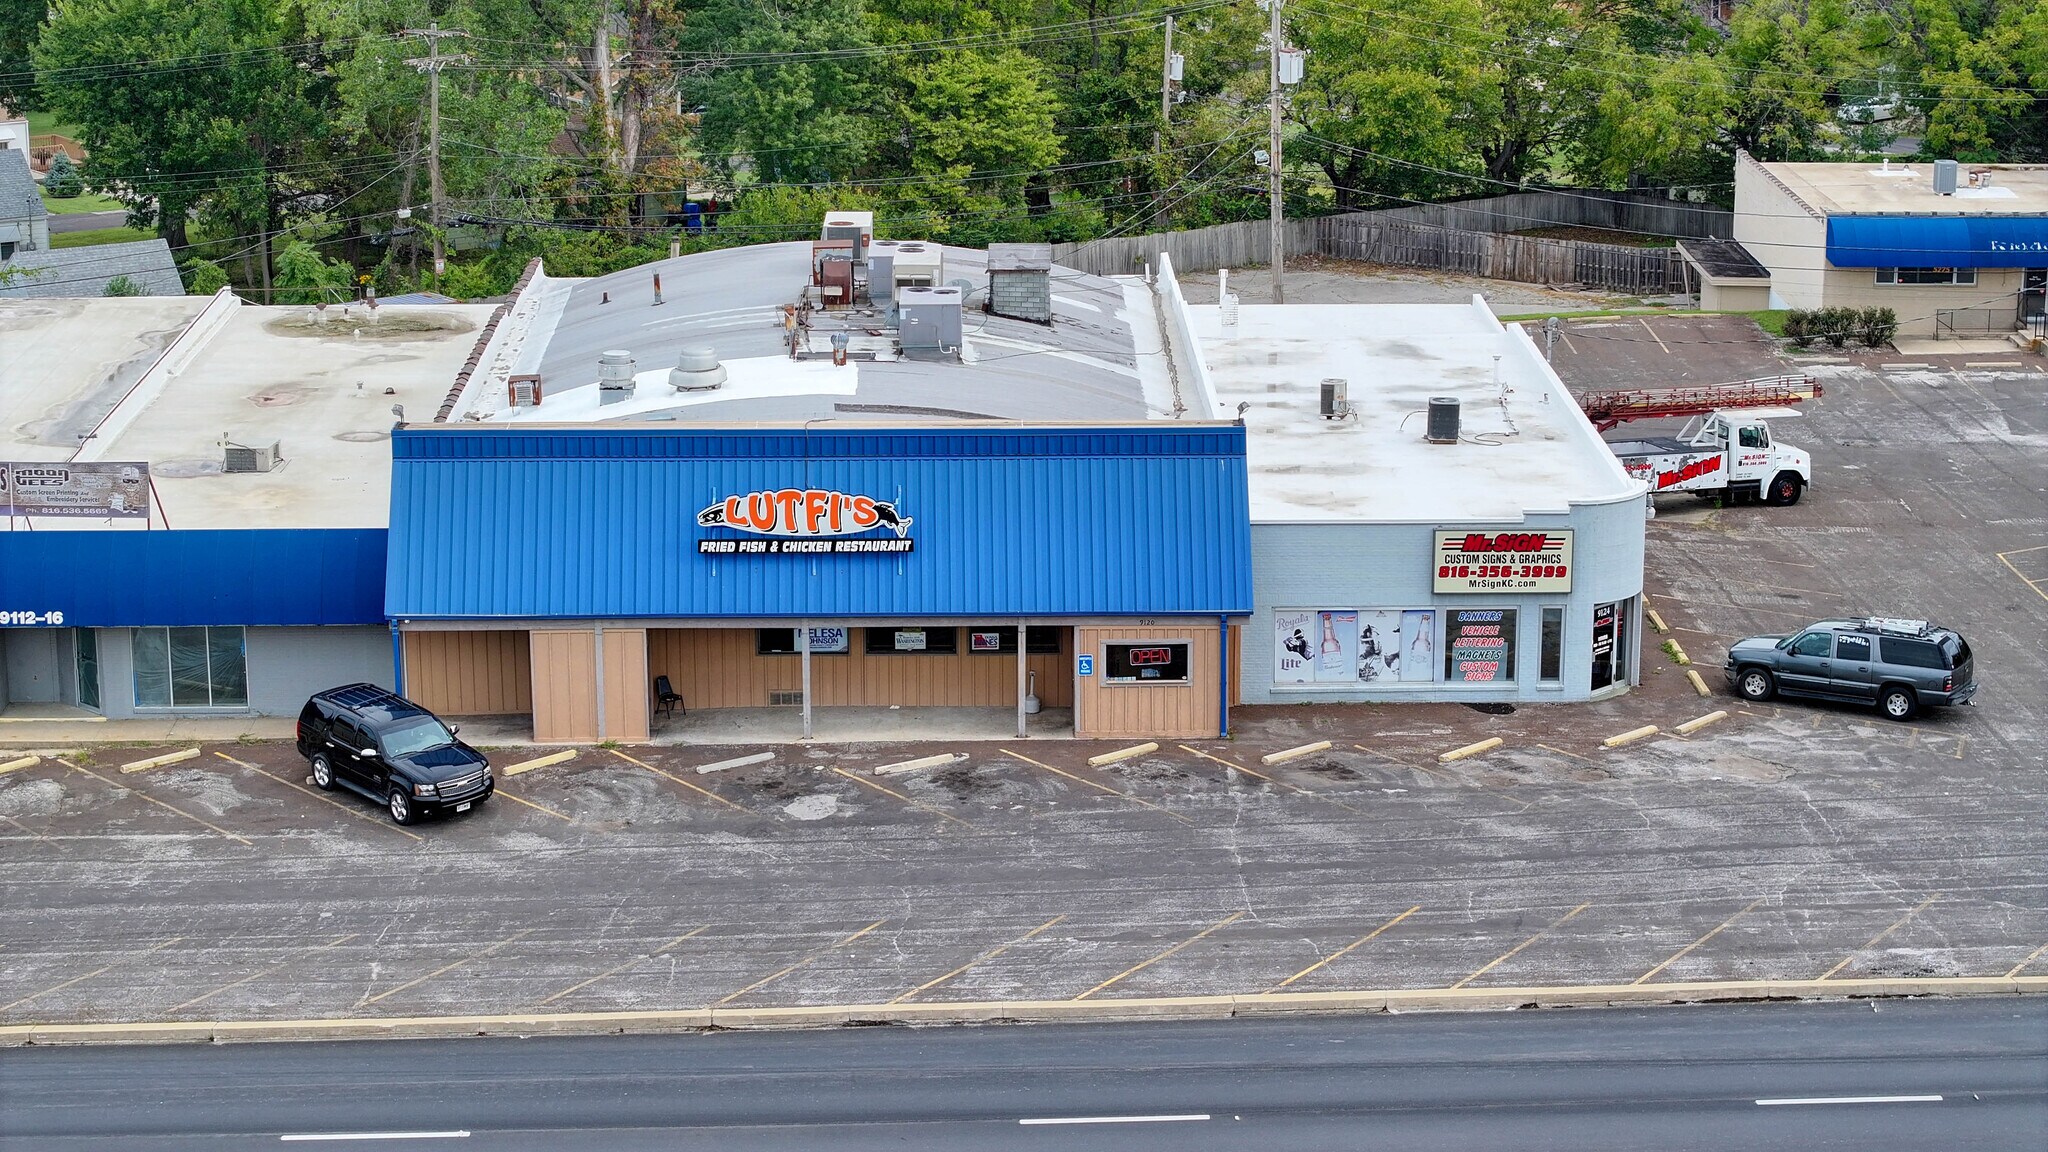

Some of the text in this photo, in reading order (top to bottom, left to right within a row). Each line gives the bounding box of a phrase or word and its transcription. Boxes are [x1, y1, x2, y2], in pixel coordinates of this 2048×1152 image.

[56, 489, 79, 497] Printing
[725, 489, 880, 533] LUTFI'S
[700, 539, 912, 553] FRIED FISH & CHICKEN RESTAURANT
[1444, 553, 1562, 564] CUSTOM SIGNS & GRAPHICS
[1438, 565, 1568, 578] 816-356-3999
[1468, 580, 1537, 589] MrSignKC.com
[1458, 611, 1503, 622] BANNERS
[1597, 606, 1611, 618] 9124
[0, 611, 64, 625] 9112-16
[1461, 625, 1501, 635] VEHICLE
[1455, 637, 1505, 648] LETTERING
[1131, 649, 1170, 664] OPEN
[1456, 650, 1502, 660] MAGNETS
[1280, 658, 1302, 671] Lite
[1460, 661, 1499, 671] CUSTOM
[1464, 671, 1495, 681] SIGNS
